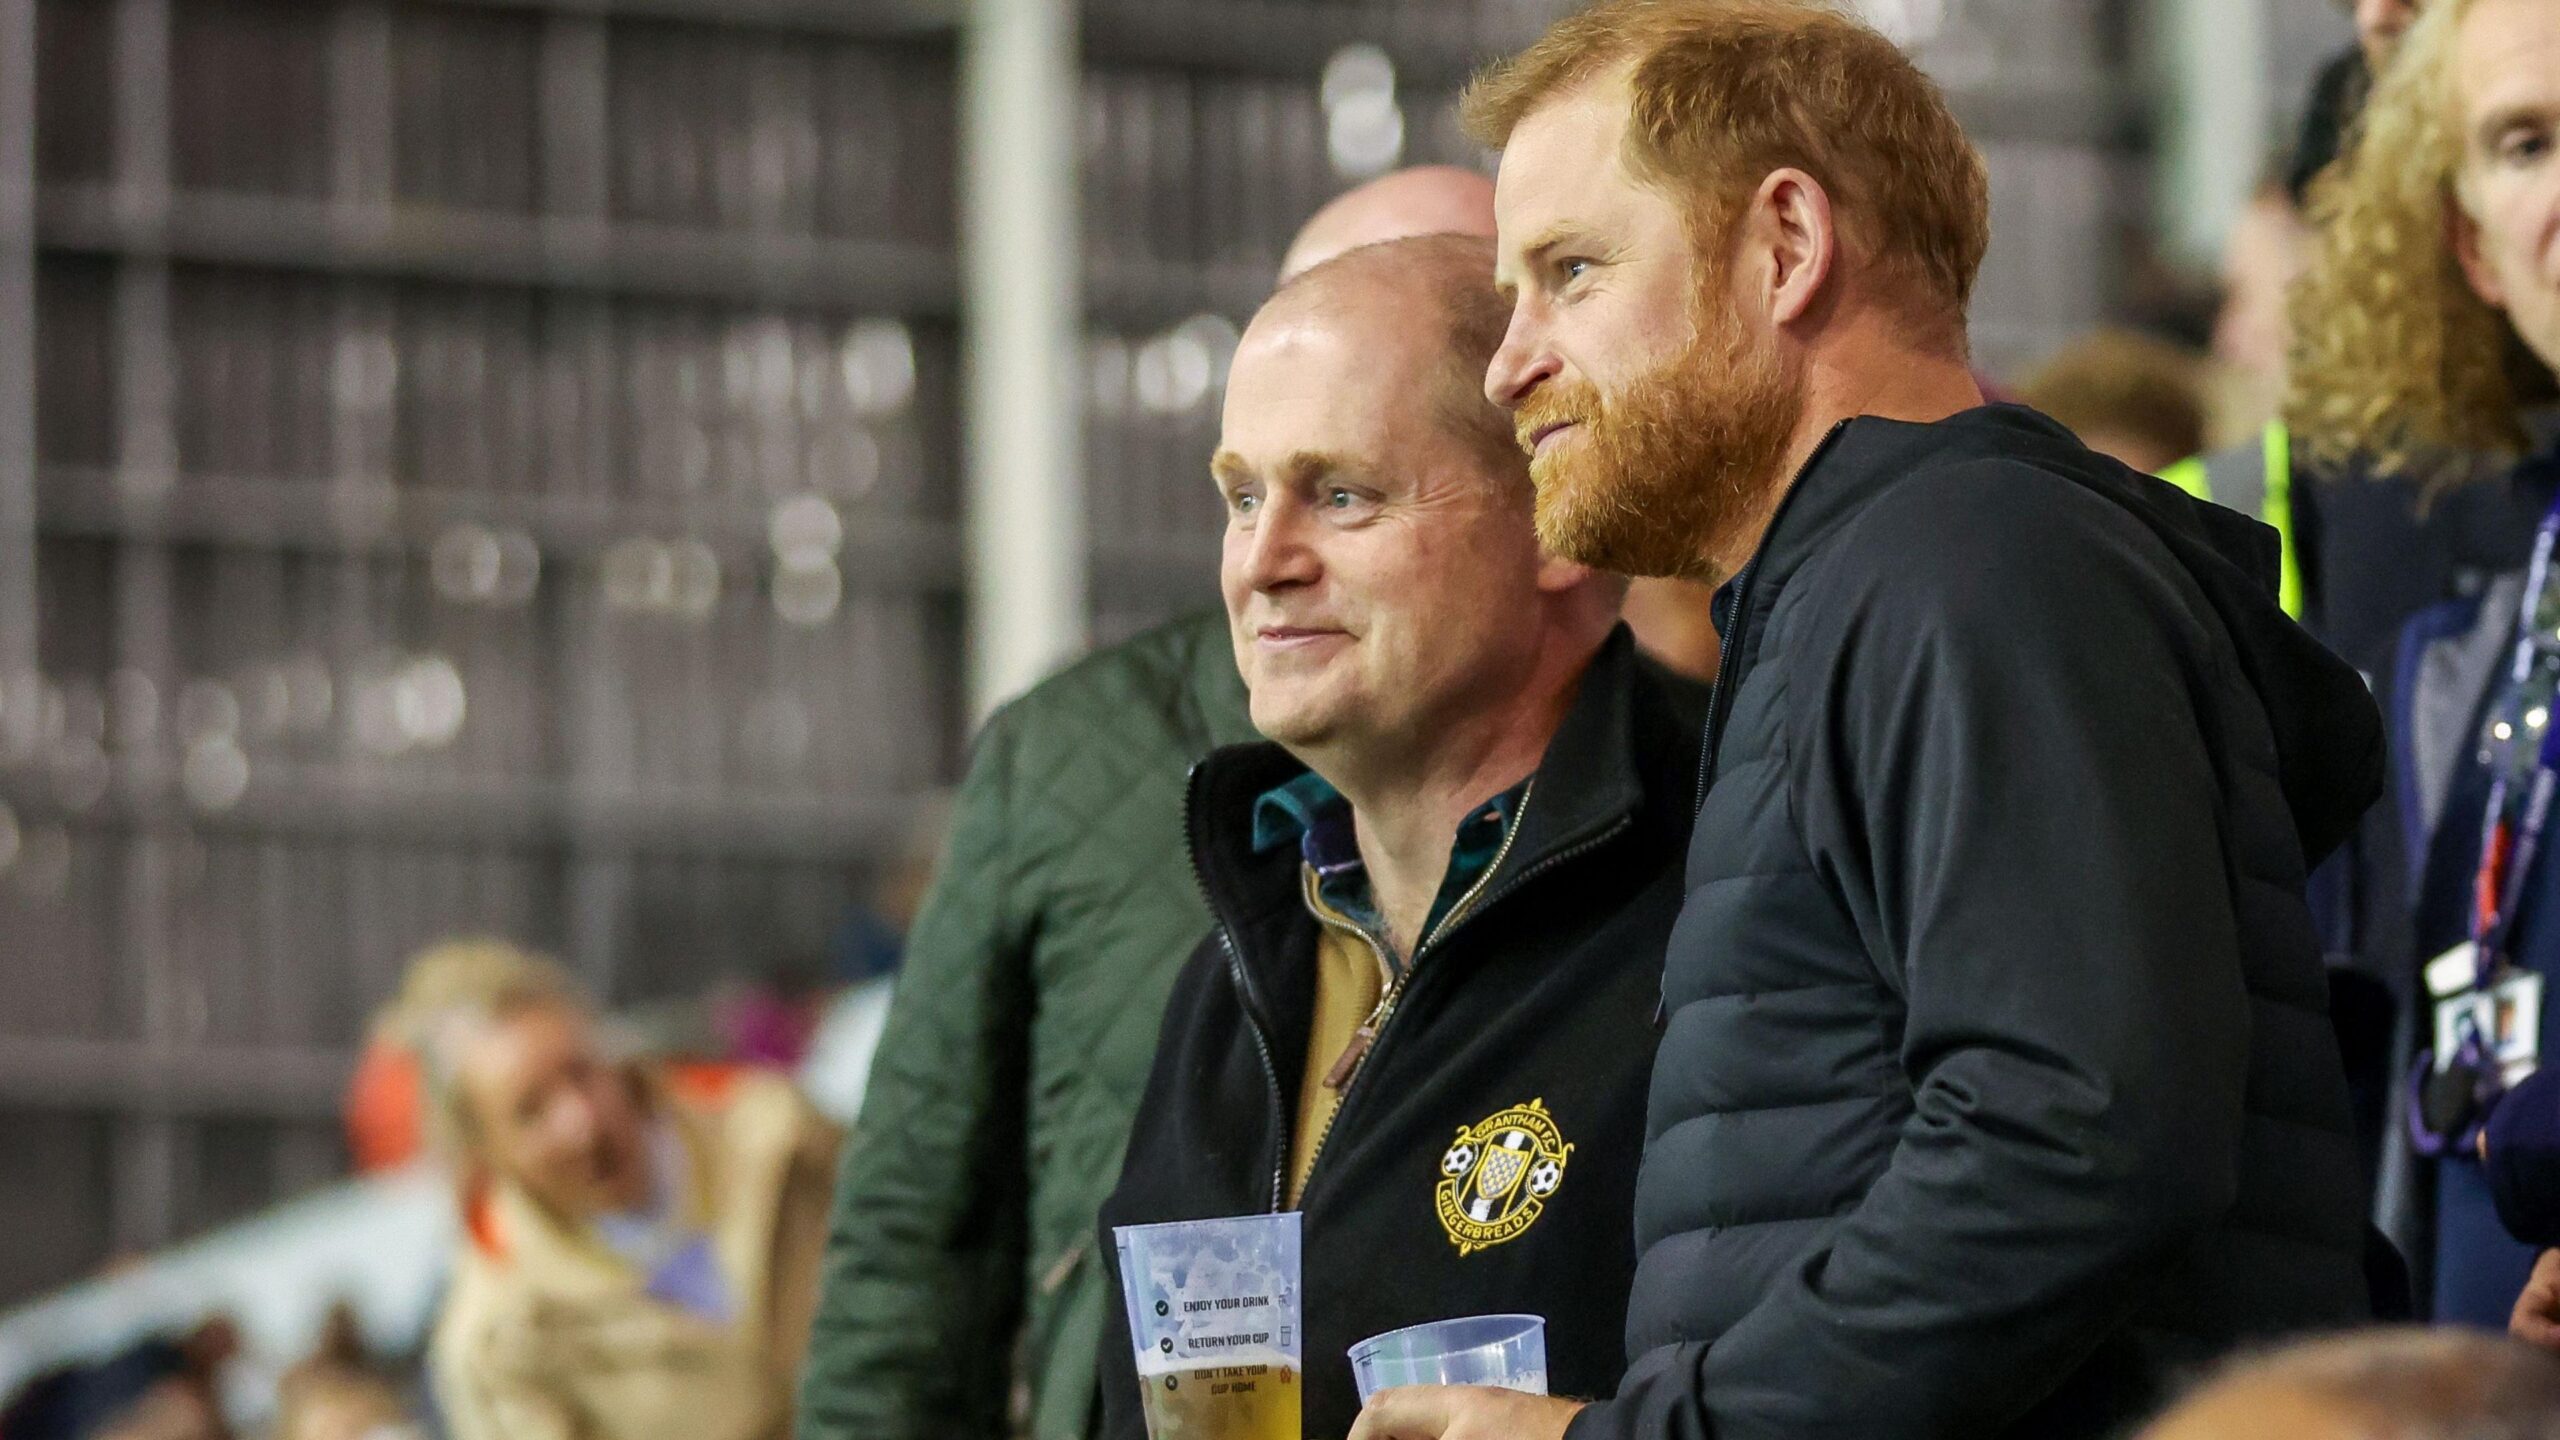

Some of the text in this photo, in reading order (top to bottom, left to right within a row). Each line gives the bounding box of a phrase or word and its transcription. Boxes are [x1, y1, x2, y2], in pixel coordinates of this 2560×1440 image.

[1475, 1114, 1546, 1137] GRANTHAM
[1440, 1189, 1533, 1239] GINGERBREADS
[1184, 1296, 1269, 1312] ENJOY YOUR DRINK
[1188, 1332, 1269, 1349] RETURN YOUR CUP
[1222, 1366, 1244, 1377] TAKE
[1246, 1364, 1267, 1375] YOUR
[1211, 1383, 1229, 1395] CUP
